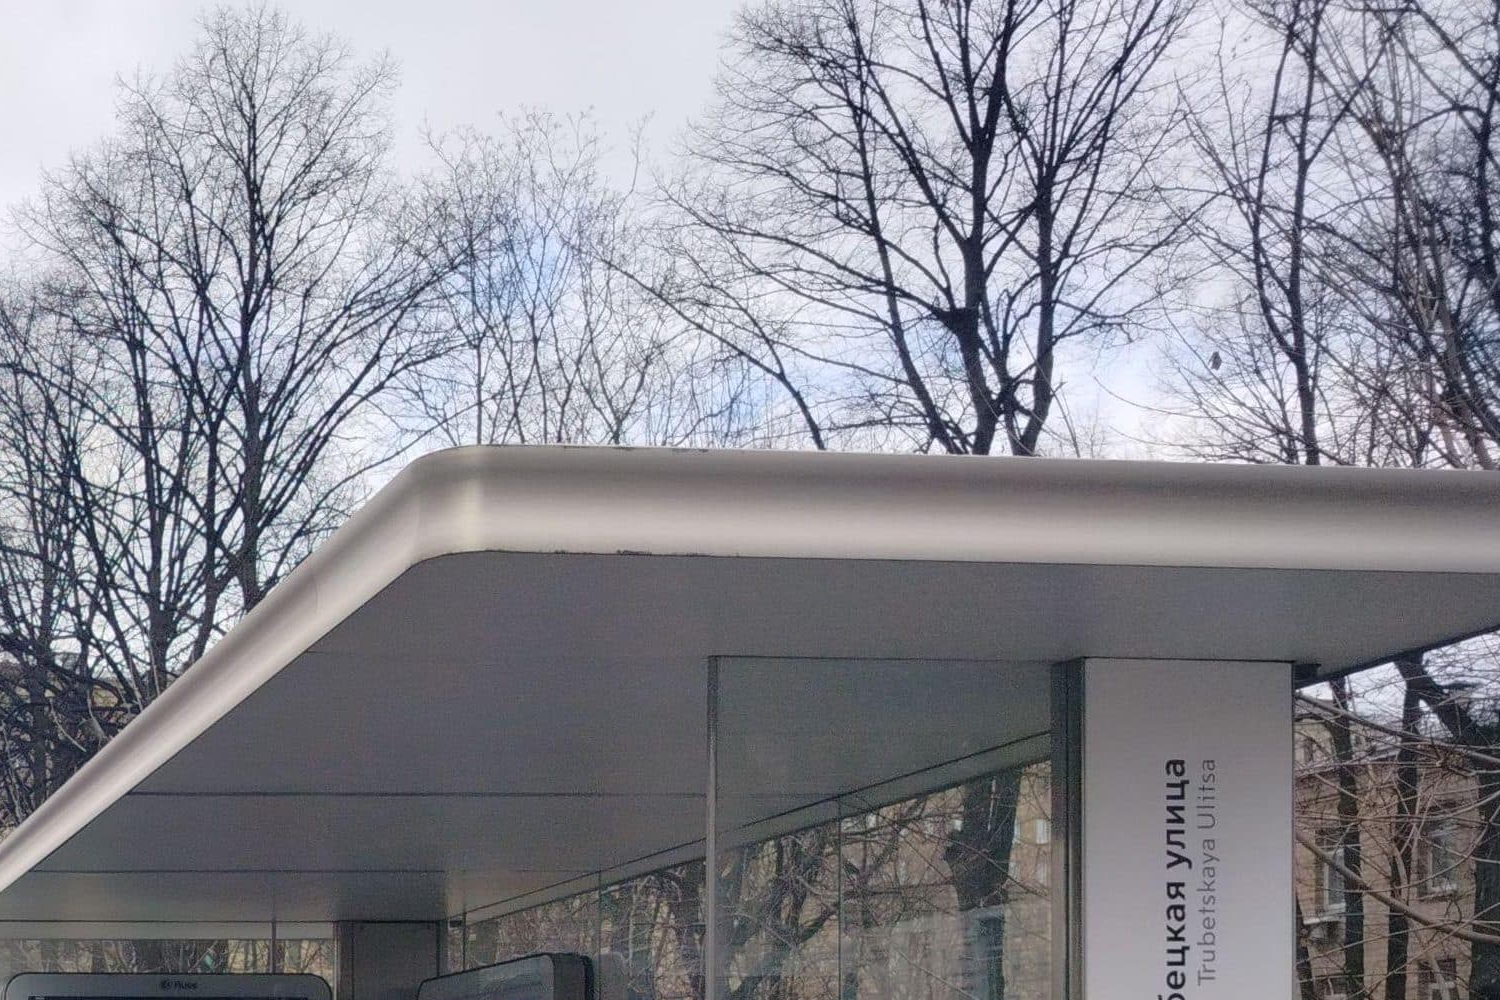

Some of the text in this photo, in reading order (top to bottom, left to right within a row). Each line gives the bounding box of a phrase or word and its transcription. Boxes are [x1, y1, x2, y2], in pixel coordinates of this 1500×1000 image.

[1165, 758, 1193, 870] улица
[1197, 758, 1220, 986] Trubetskaya Ulitsa
